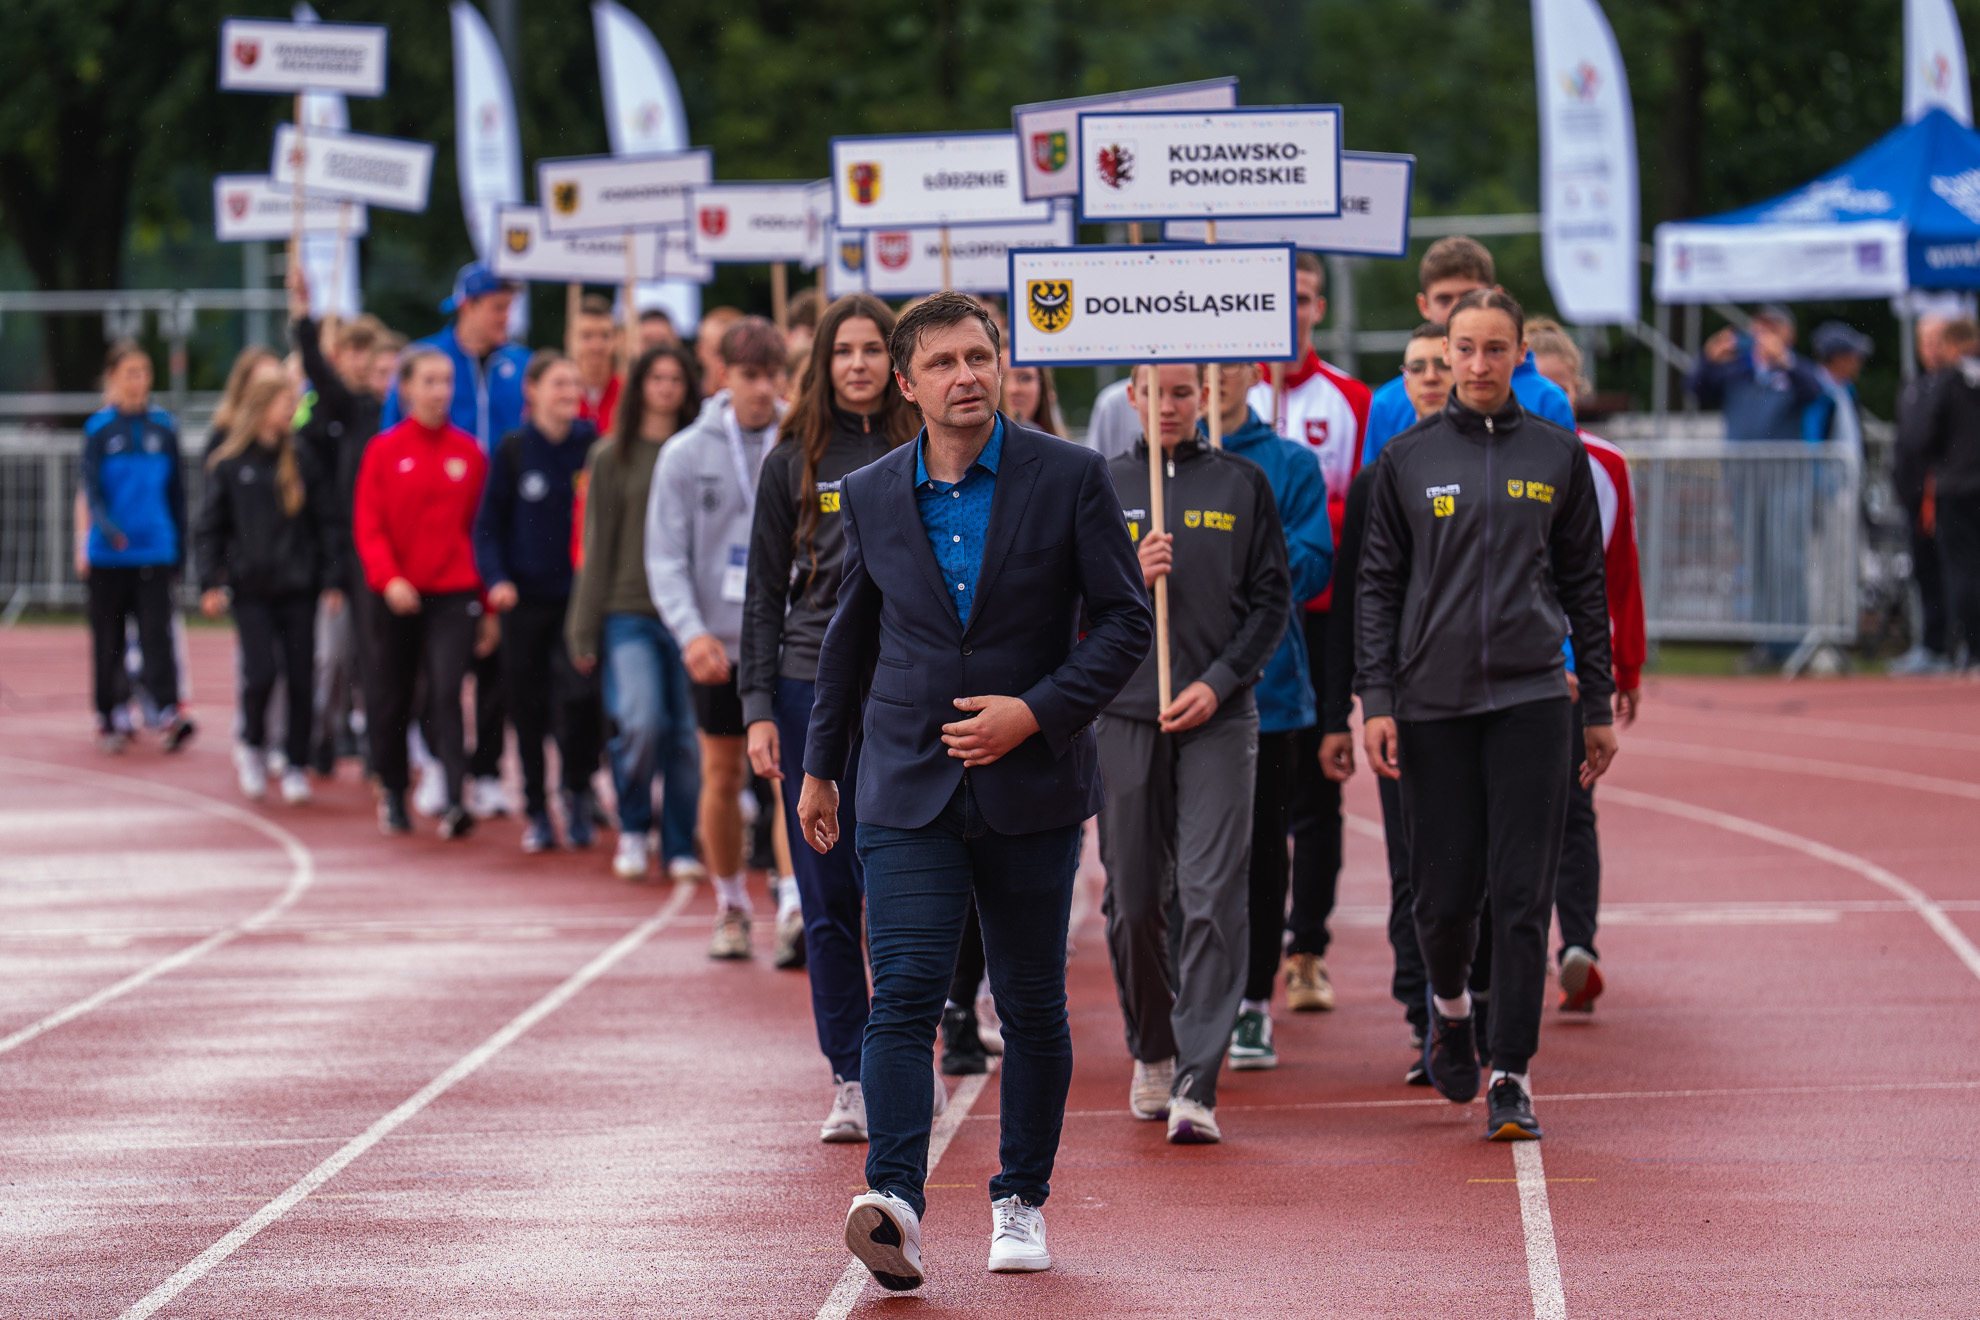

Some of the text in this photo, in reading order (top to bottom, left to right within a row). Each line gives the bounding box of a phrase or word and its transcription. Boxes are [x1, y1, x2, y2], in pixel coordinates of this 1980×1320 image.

[1168, 142, 1307, 163] KUJAWSKO-
[1169, 166, 1306, 187] POMORSKIE
[1085, 290, 1276, 317] DOLNOŚLĄSKIE
